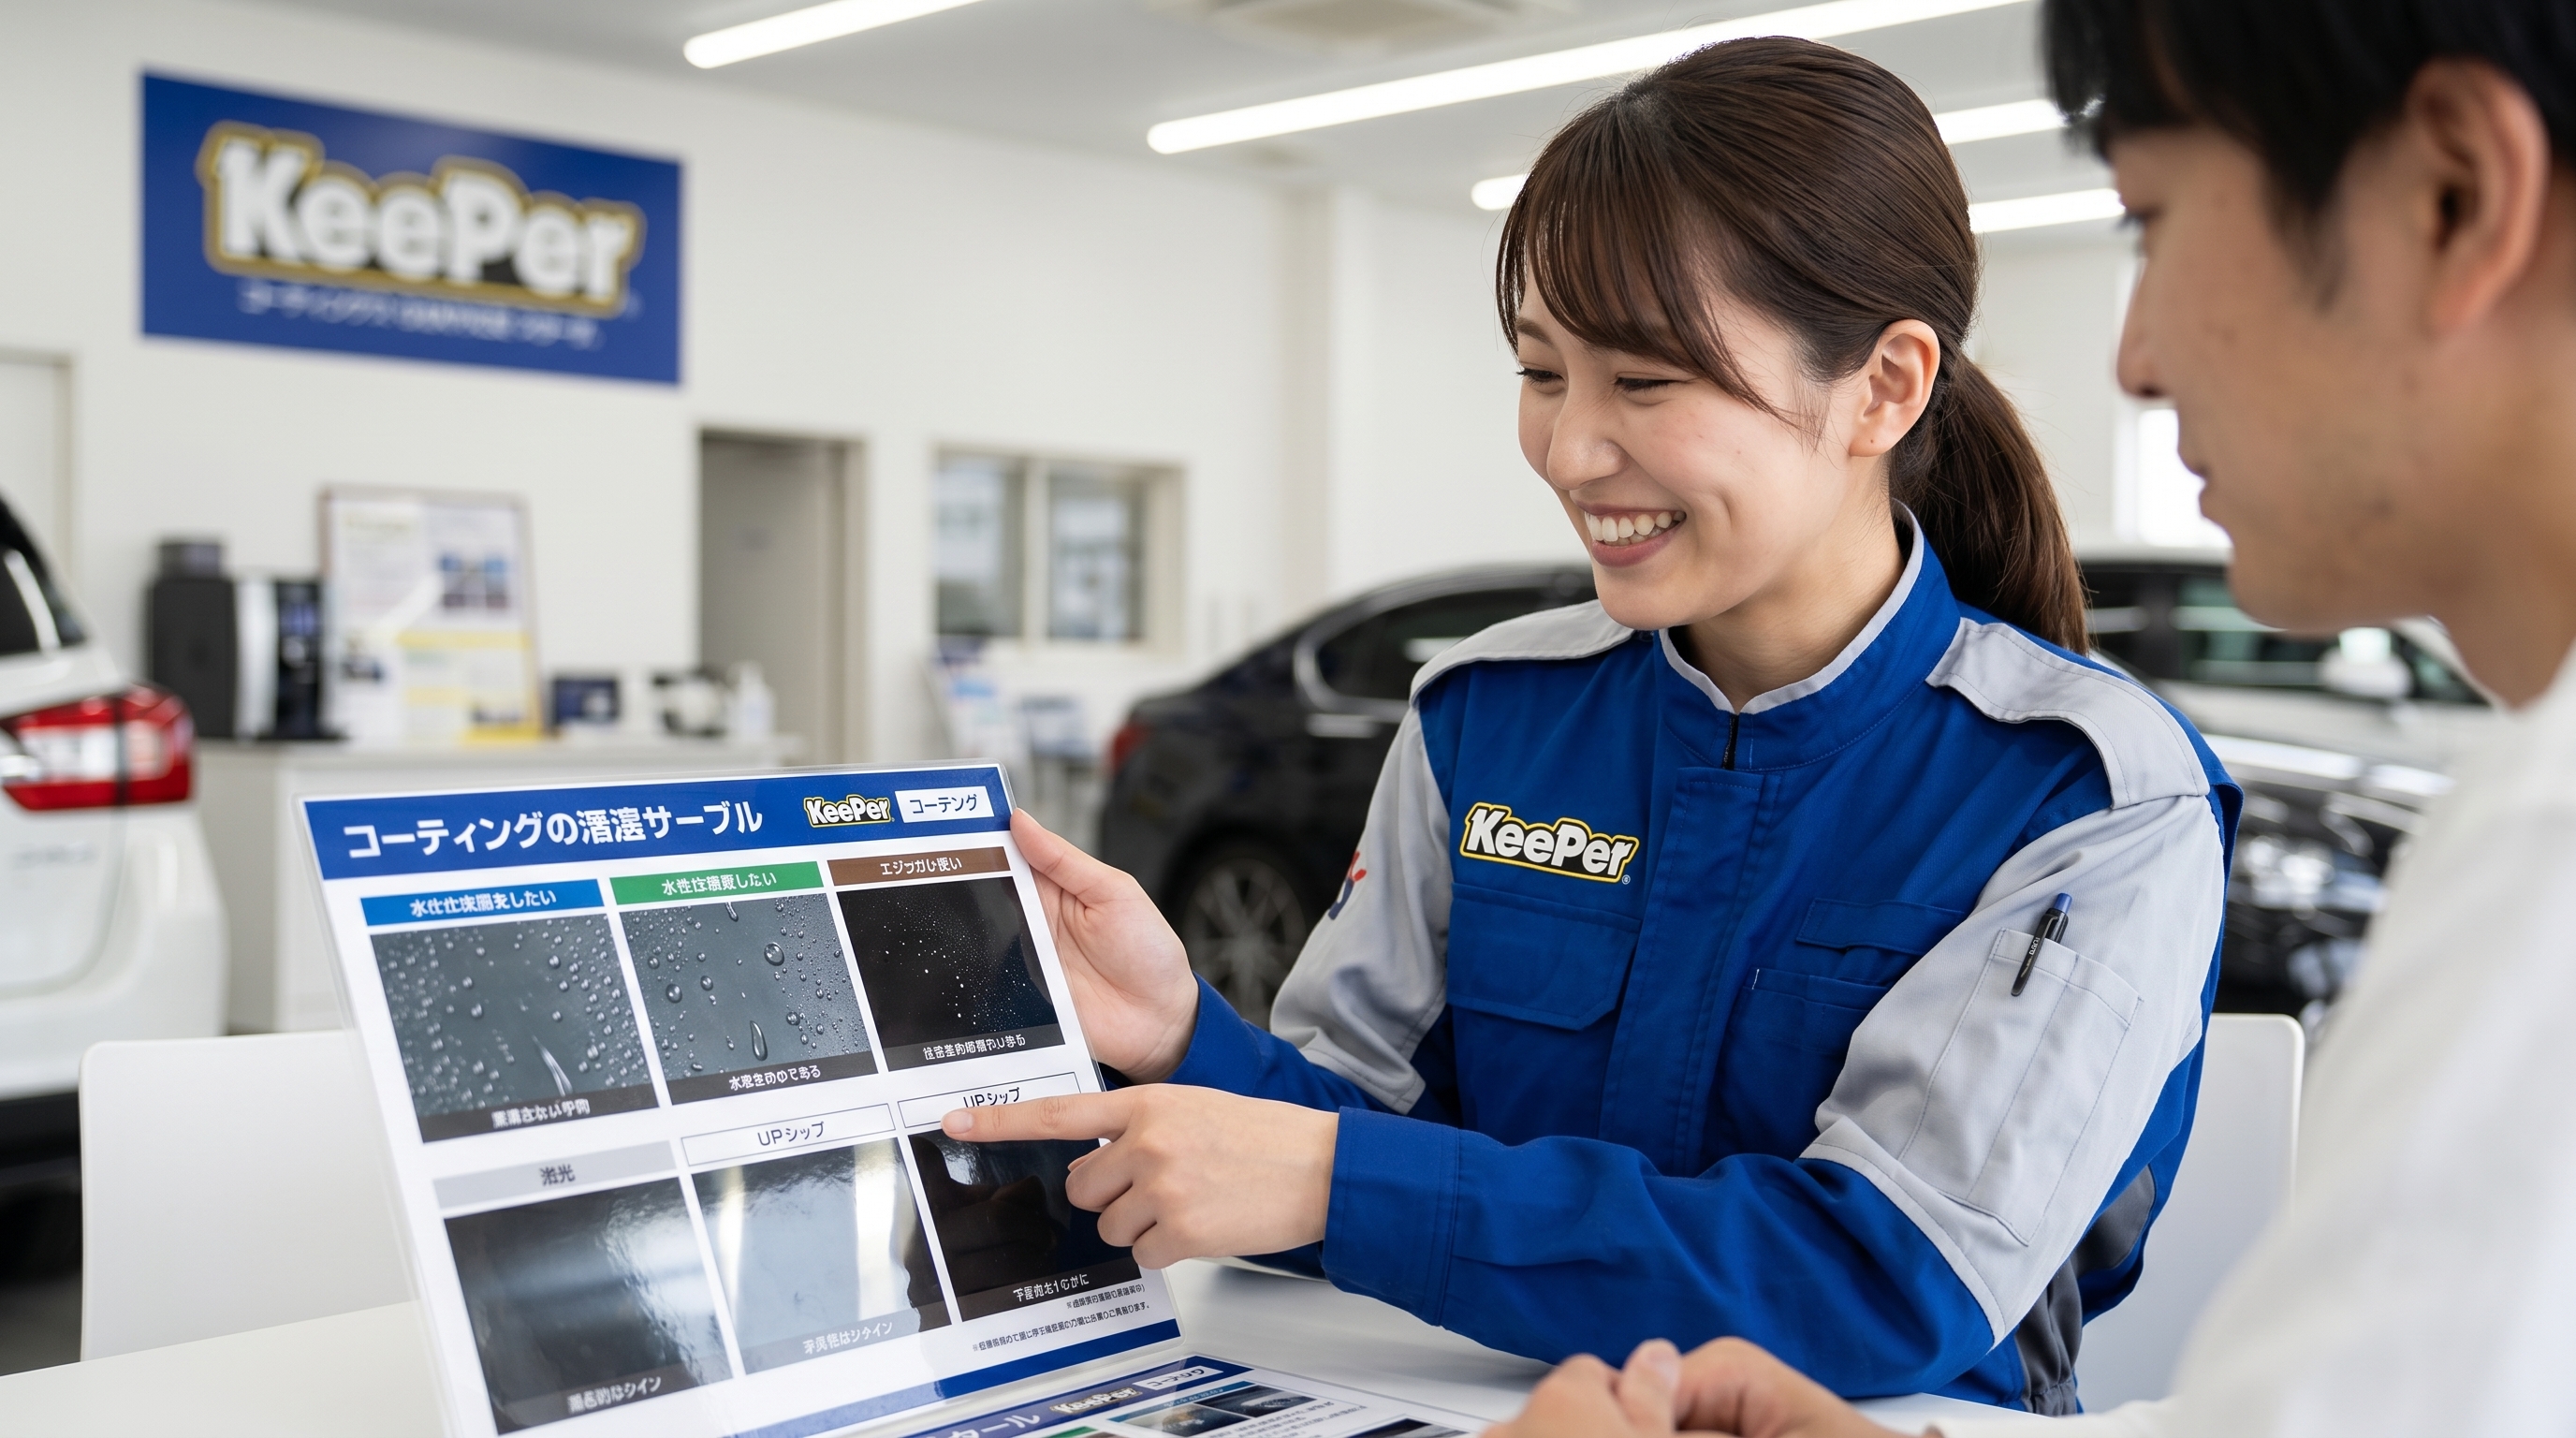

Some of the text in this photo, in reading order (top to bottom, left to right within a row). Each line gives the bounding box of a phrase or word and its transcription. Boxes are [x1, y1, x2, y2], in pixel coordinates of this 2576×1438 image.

[208, 129, 640, 307] KeePer
[805, 795, 890, 827] KeePer
[909, 794, 978, 814] コーテング
[1463, 805, 1636, 880] KeePer
